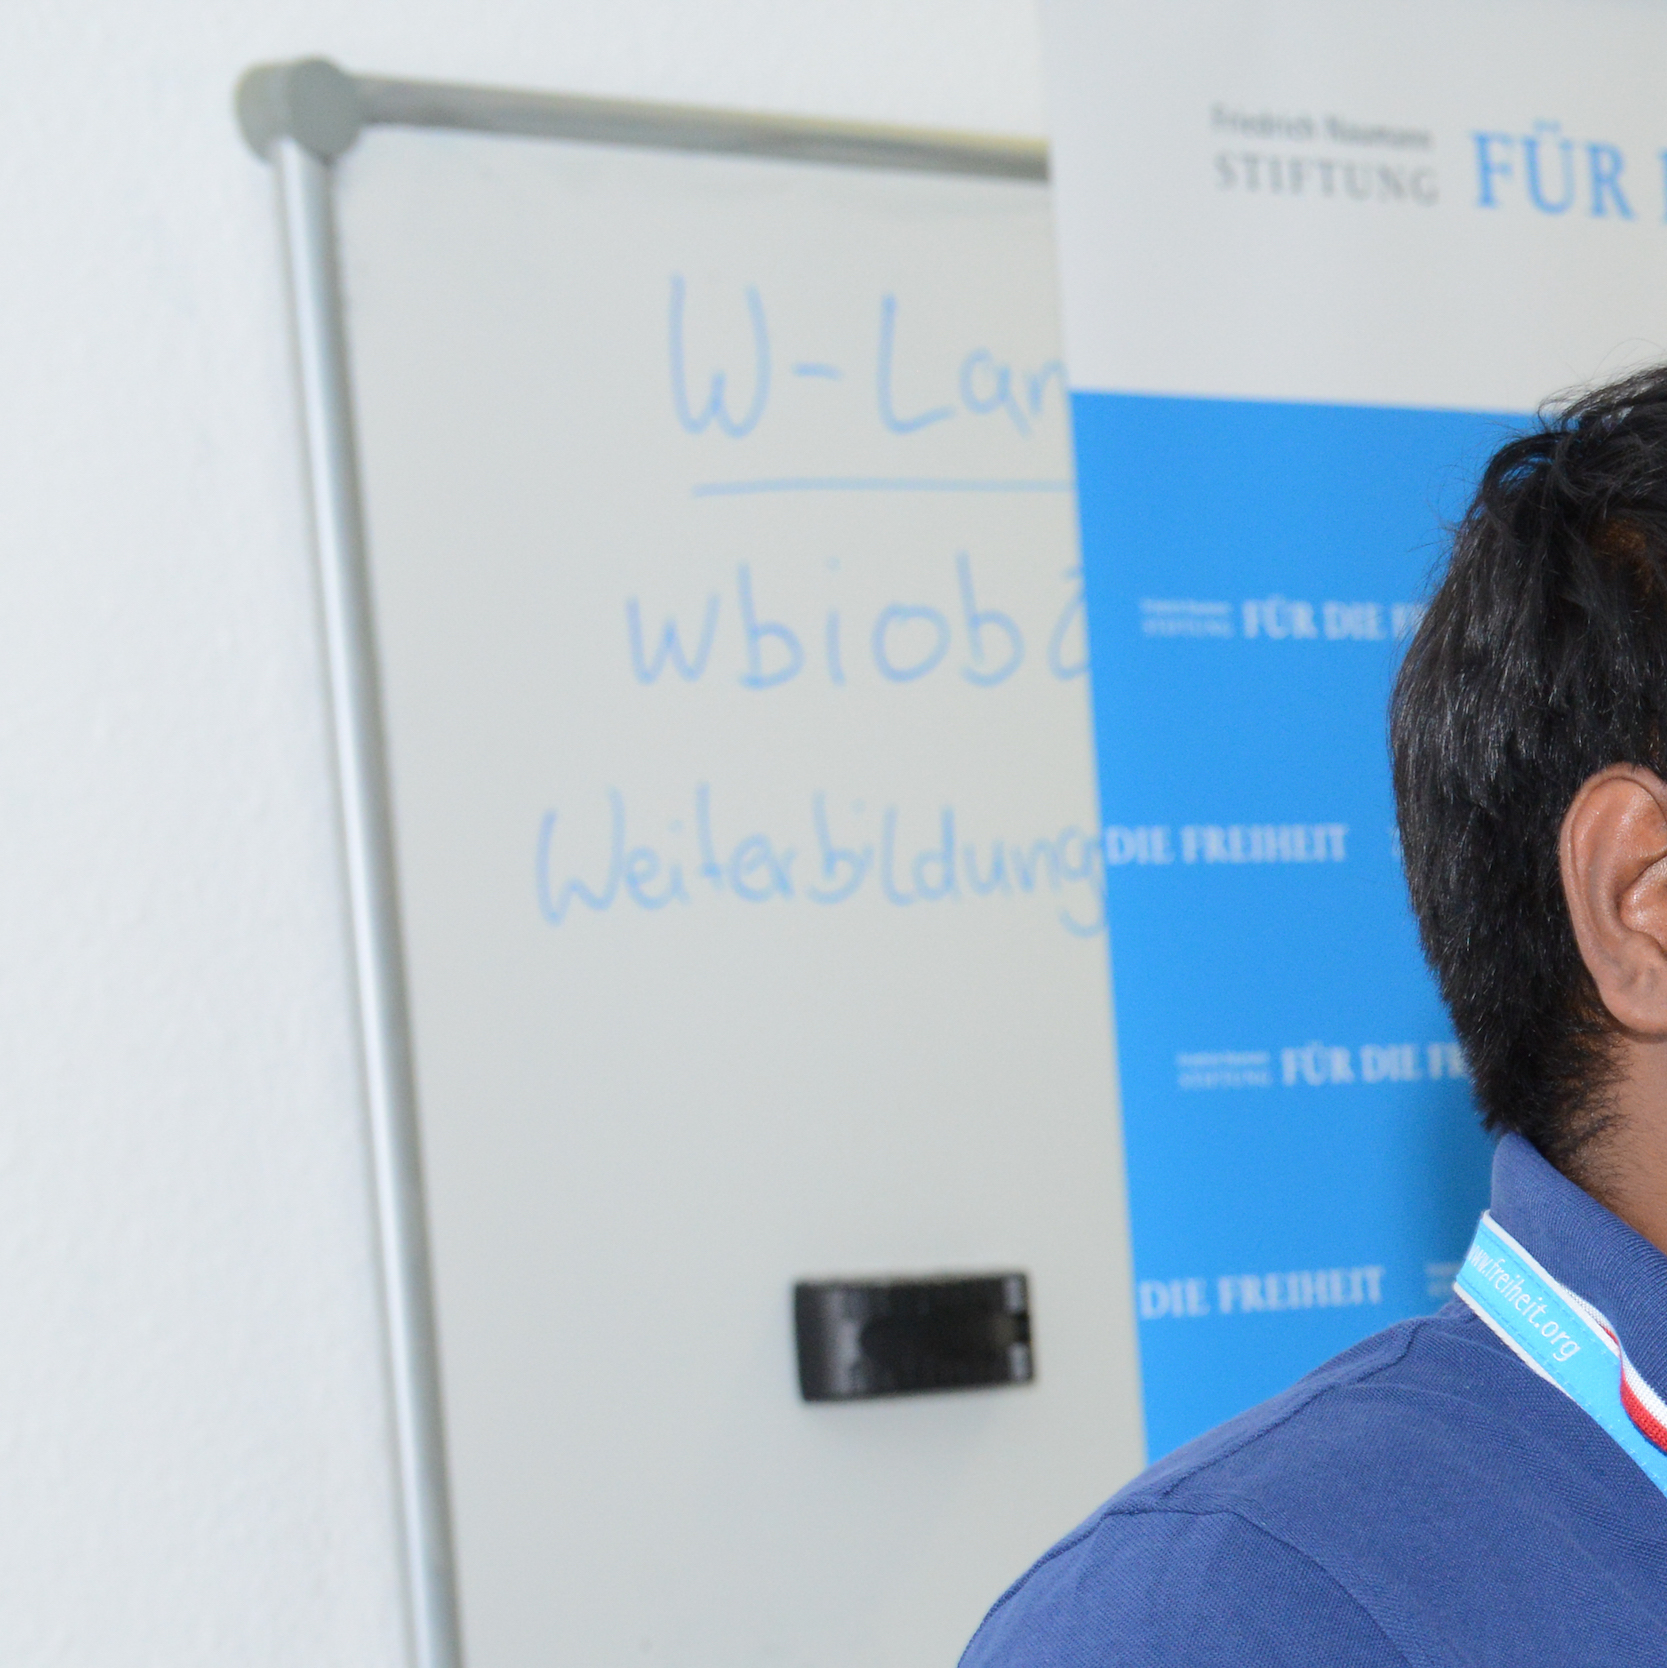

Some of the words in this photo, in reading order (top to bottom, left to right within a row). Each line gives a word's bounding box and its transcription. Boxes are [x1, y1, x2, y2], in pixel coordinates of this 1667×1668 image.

[1213, 152, 1440, 207] STIFTUNG
[1472, 118, 1636, 221] FÜR
[1242, 595, 1318, 639] FÜR
[1322, 602, 1387, 640] DIE
[1105, 824, 1174, 865] DIE
[1181, 823, 1349, 864] FREIHEIT
[1280, 1040, 1354, 1087] FÜR
[1360, 1044, 1422, 1084] DIE
[1139, 1278, 1211, 1321] DIE
[1217, 1264, 1386, 1315] FREIHEIT
